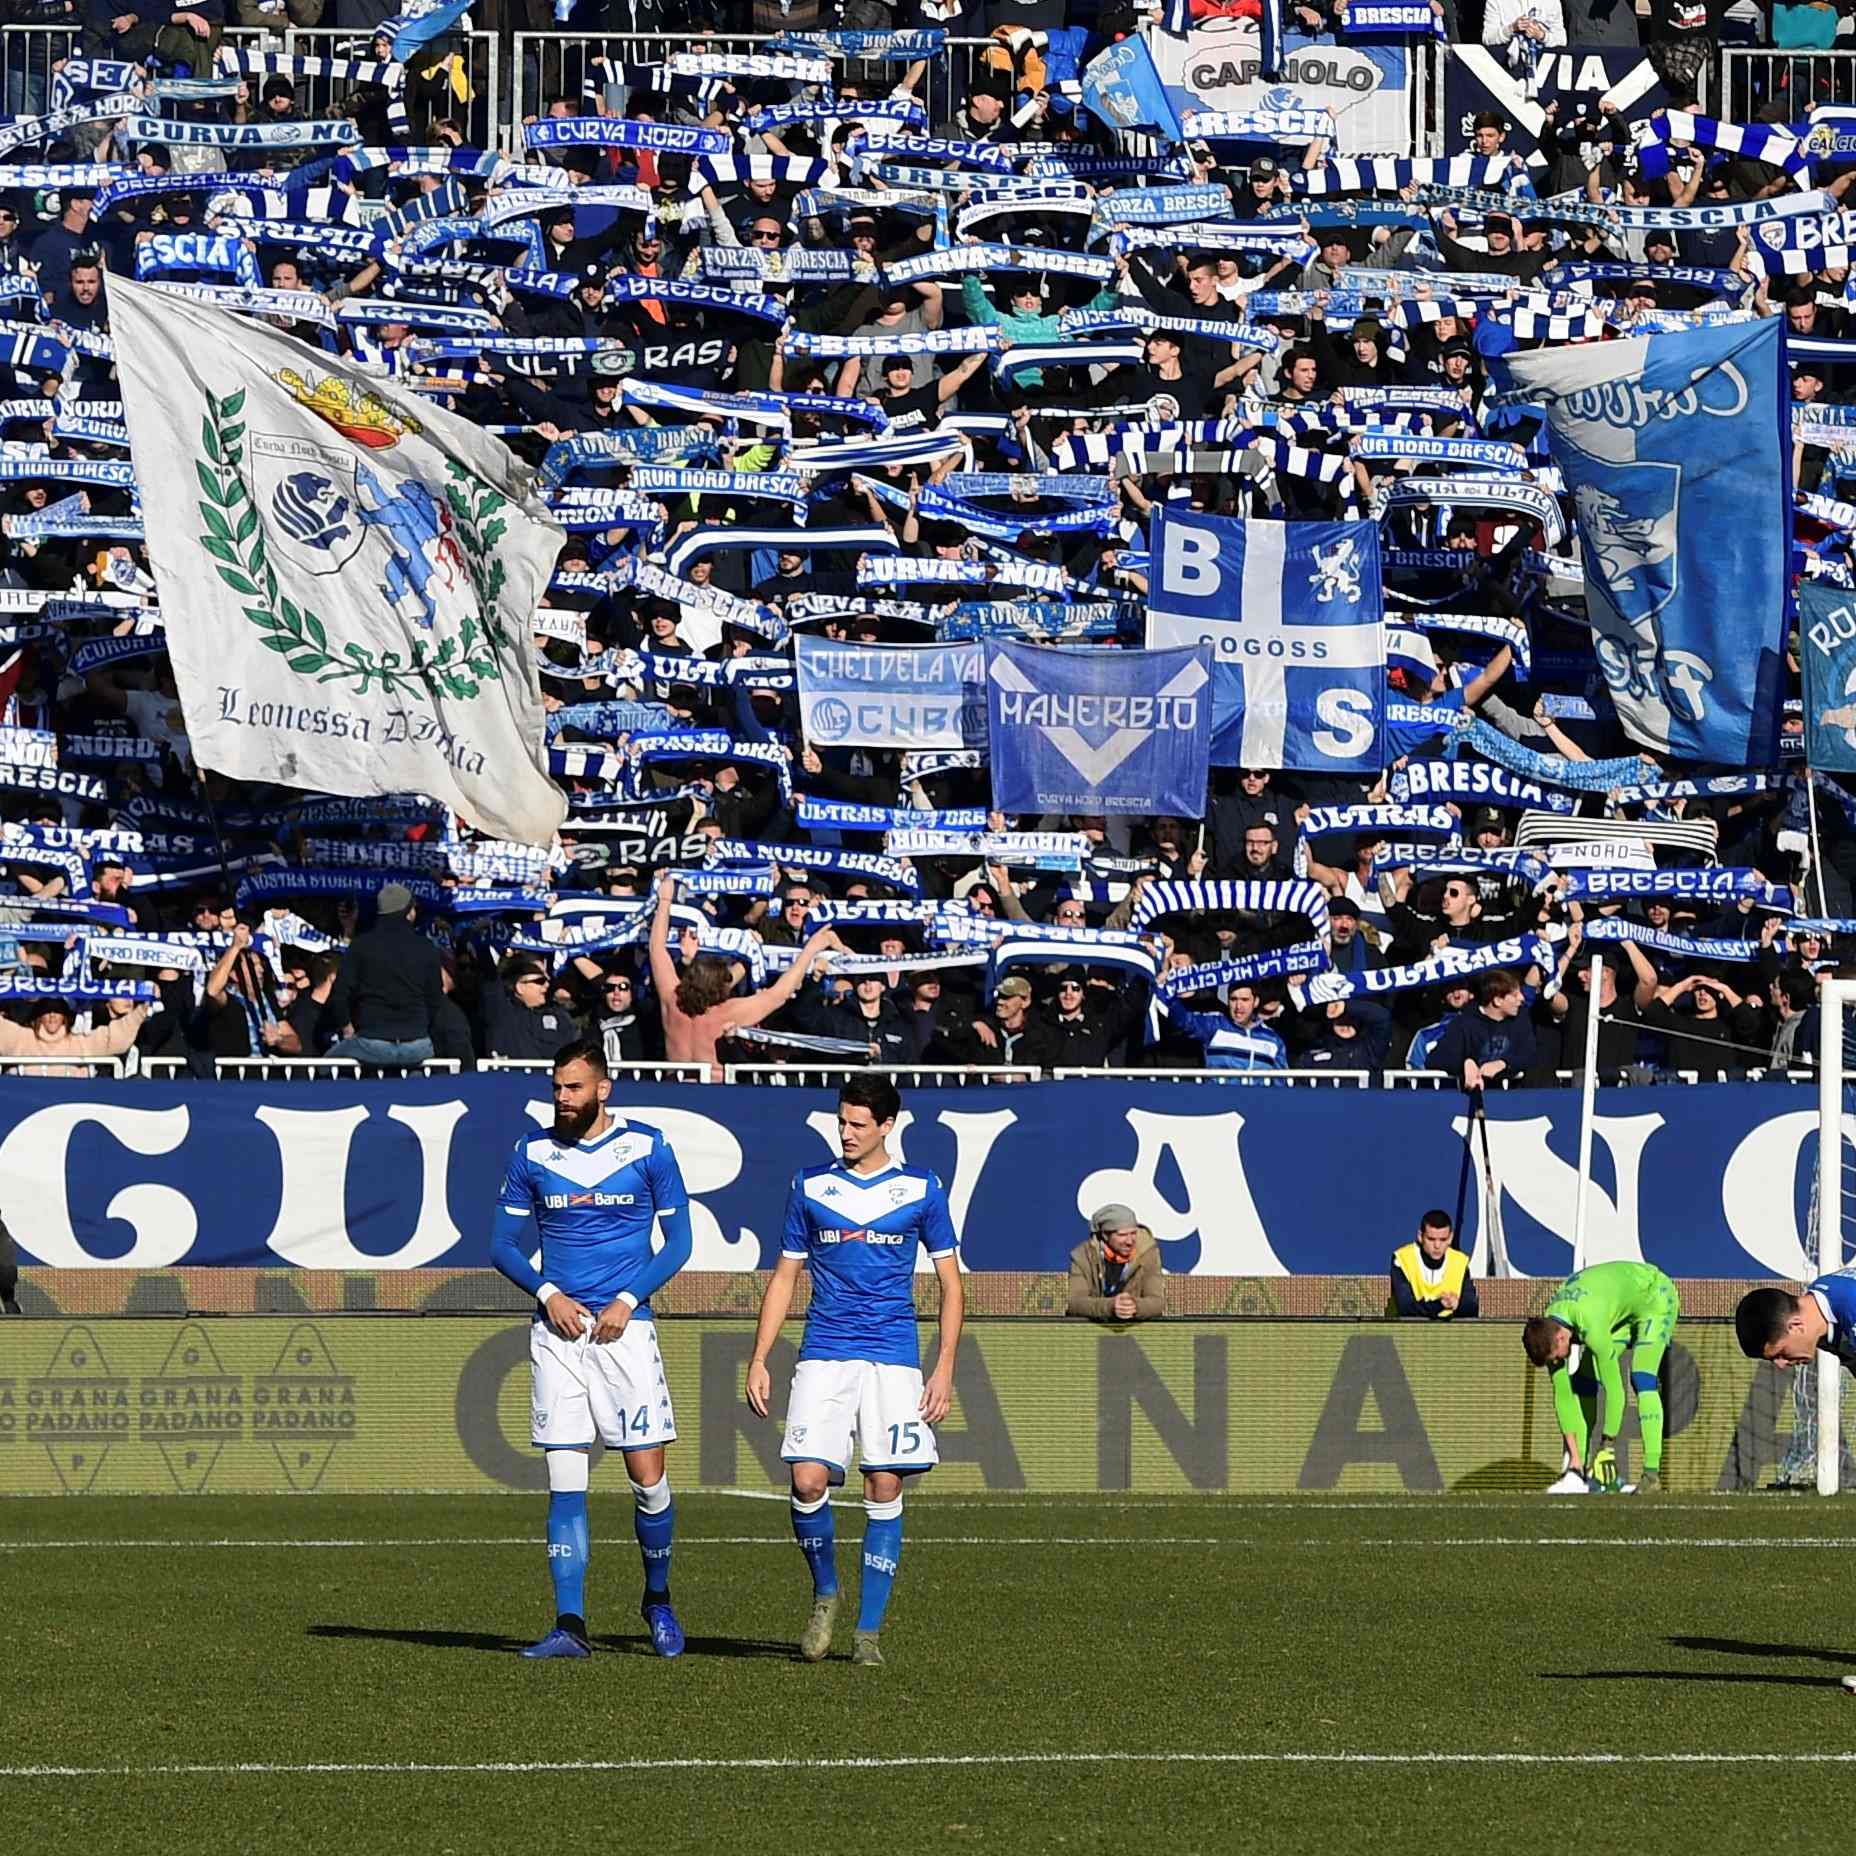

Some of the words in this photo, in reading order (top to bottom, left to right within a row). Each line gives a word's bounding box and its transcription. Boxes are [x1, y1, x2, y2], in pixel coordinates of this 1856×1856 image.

[1192, 59, 1373, 92] CAPIOLO
[506, 353, 583, 376] ULT
[644, 340, 724, 370] RAS
[1162, 523, 1223, 596] B
[217, 685, 373, 742] Leonessa
[998, 693, 1198, 730] MANERBIO
[1312, 687, 1375, 758] S
[1408, 761, 1543, 801] BRESCIA
[1587, 869, 1734, 892] BRESCIA
[544, 1194, 569, 1208] UBI
[594, 1192, 634, 1206] Banca
[818, 1229, 841, 1243] UBI
[865, 1230, 903, 1245] Banca
[27, 1388, 129, 1407] GRANA
[253, 1388, 355, 1406] GRANA
[25, 1411, 129, 1431] PADANO
[253, 1410, 356, 1430] PADANO
[617, 1404, 648, 1438] 14
[888, 1421, 921, 1455] 15
[864, 1552, 897, 1577] BSFC
